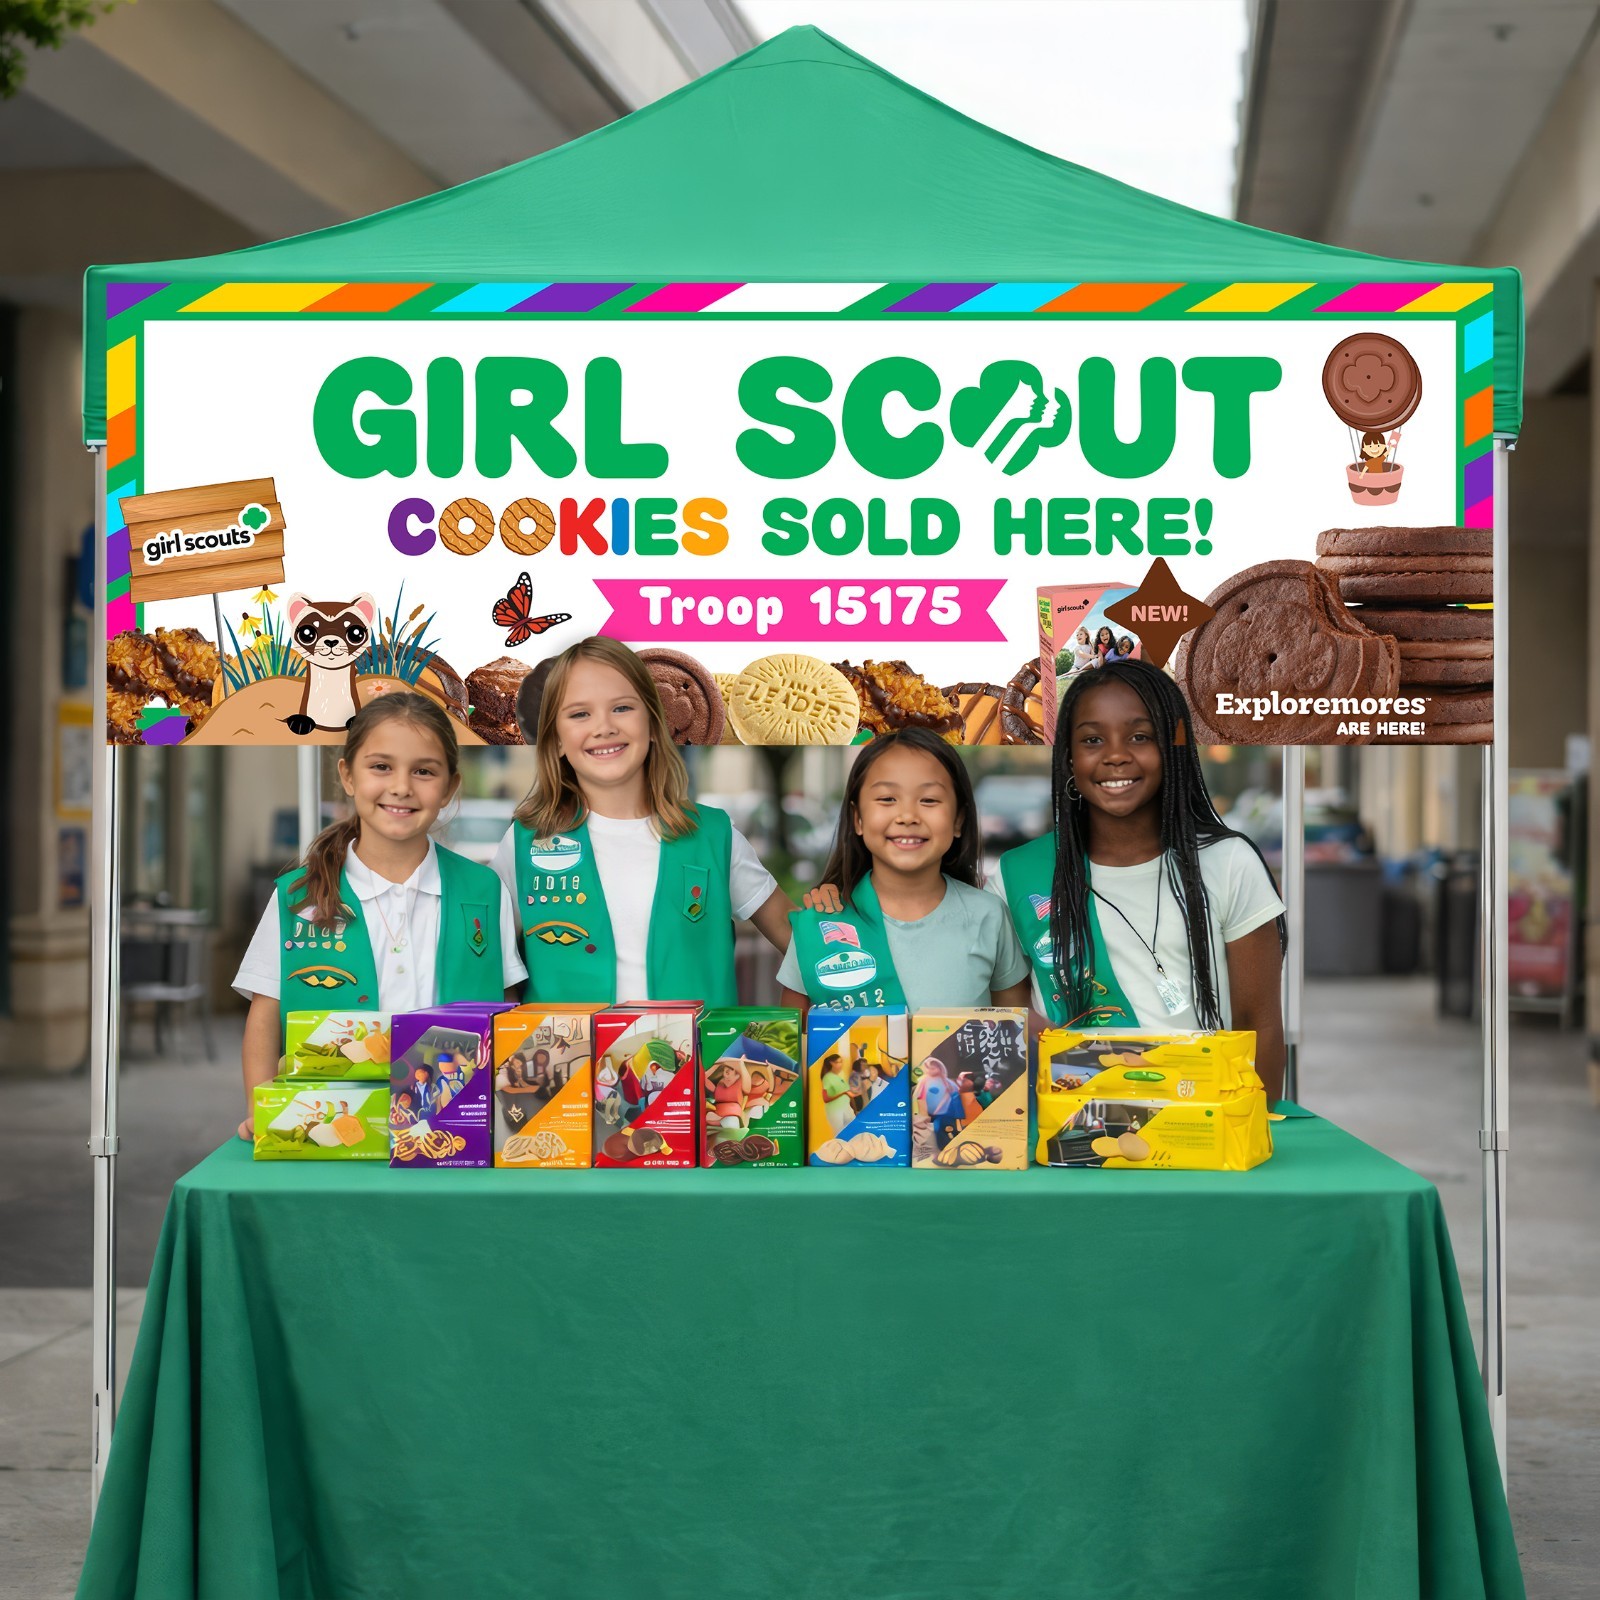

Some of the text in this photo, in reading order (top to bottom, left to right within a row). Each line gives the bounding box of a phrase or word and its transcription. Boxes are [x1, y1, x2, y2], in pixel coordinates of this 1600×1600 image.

[313, 356, 1282, 479] GIRL SCOUT
[146, 528, 251, 562] girl scouts
[388, 497, 1213, 557] COOKIES SOLD HERE!
[639, 585, 962, 635] Troop 15175
[1057, 604, 1085, 614] girl scouts
[1131, 605, 1189, 622] NEW!
[748, 683, 841, 724] LEADER
[1336, 721, 1426, 736] ARE HERE!
